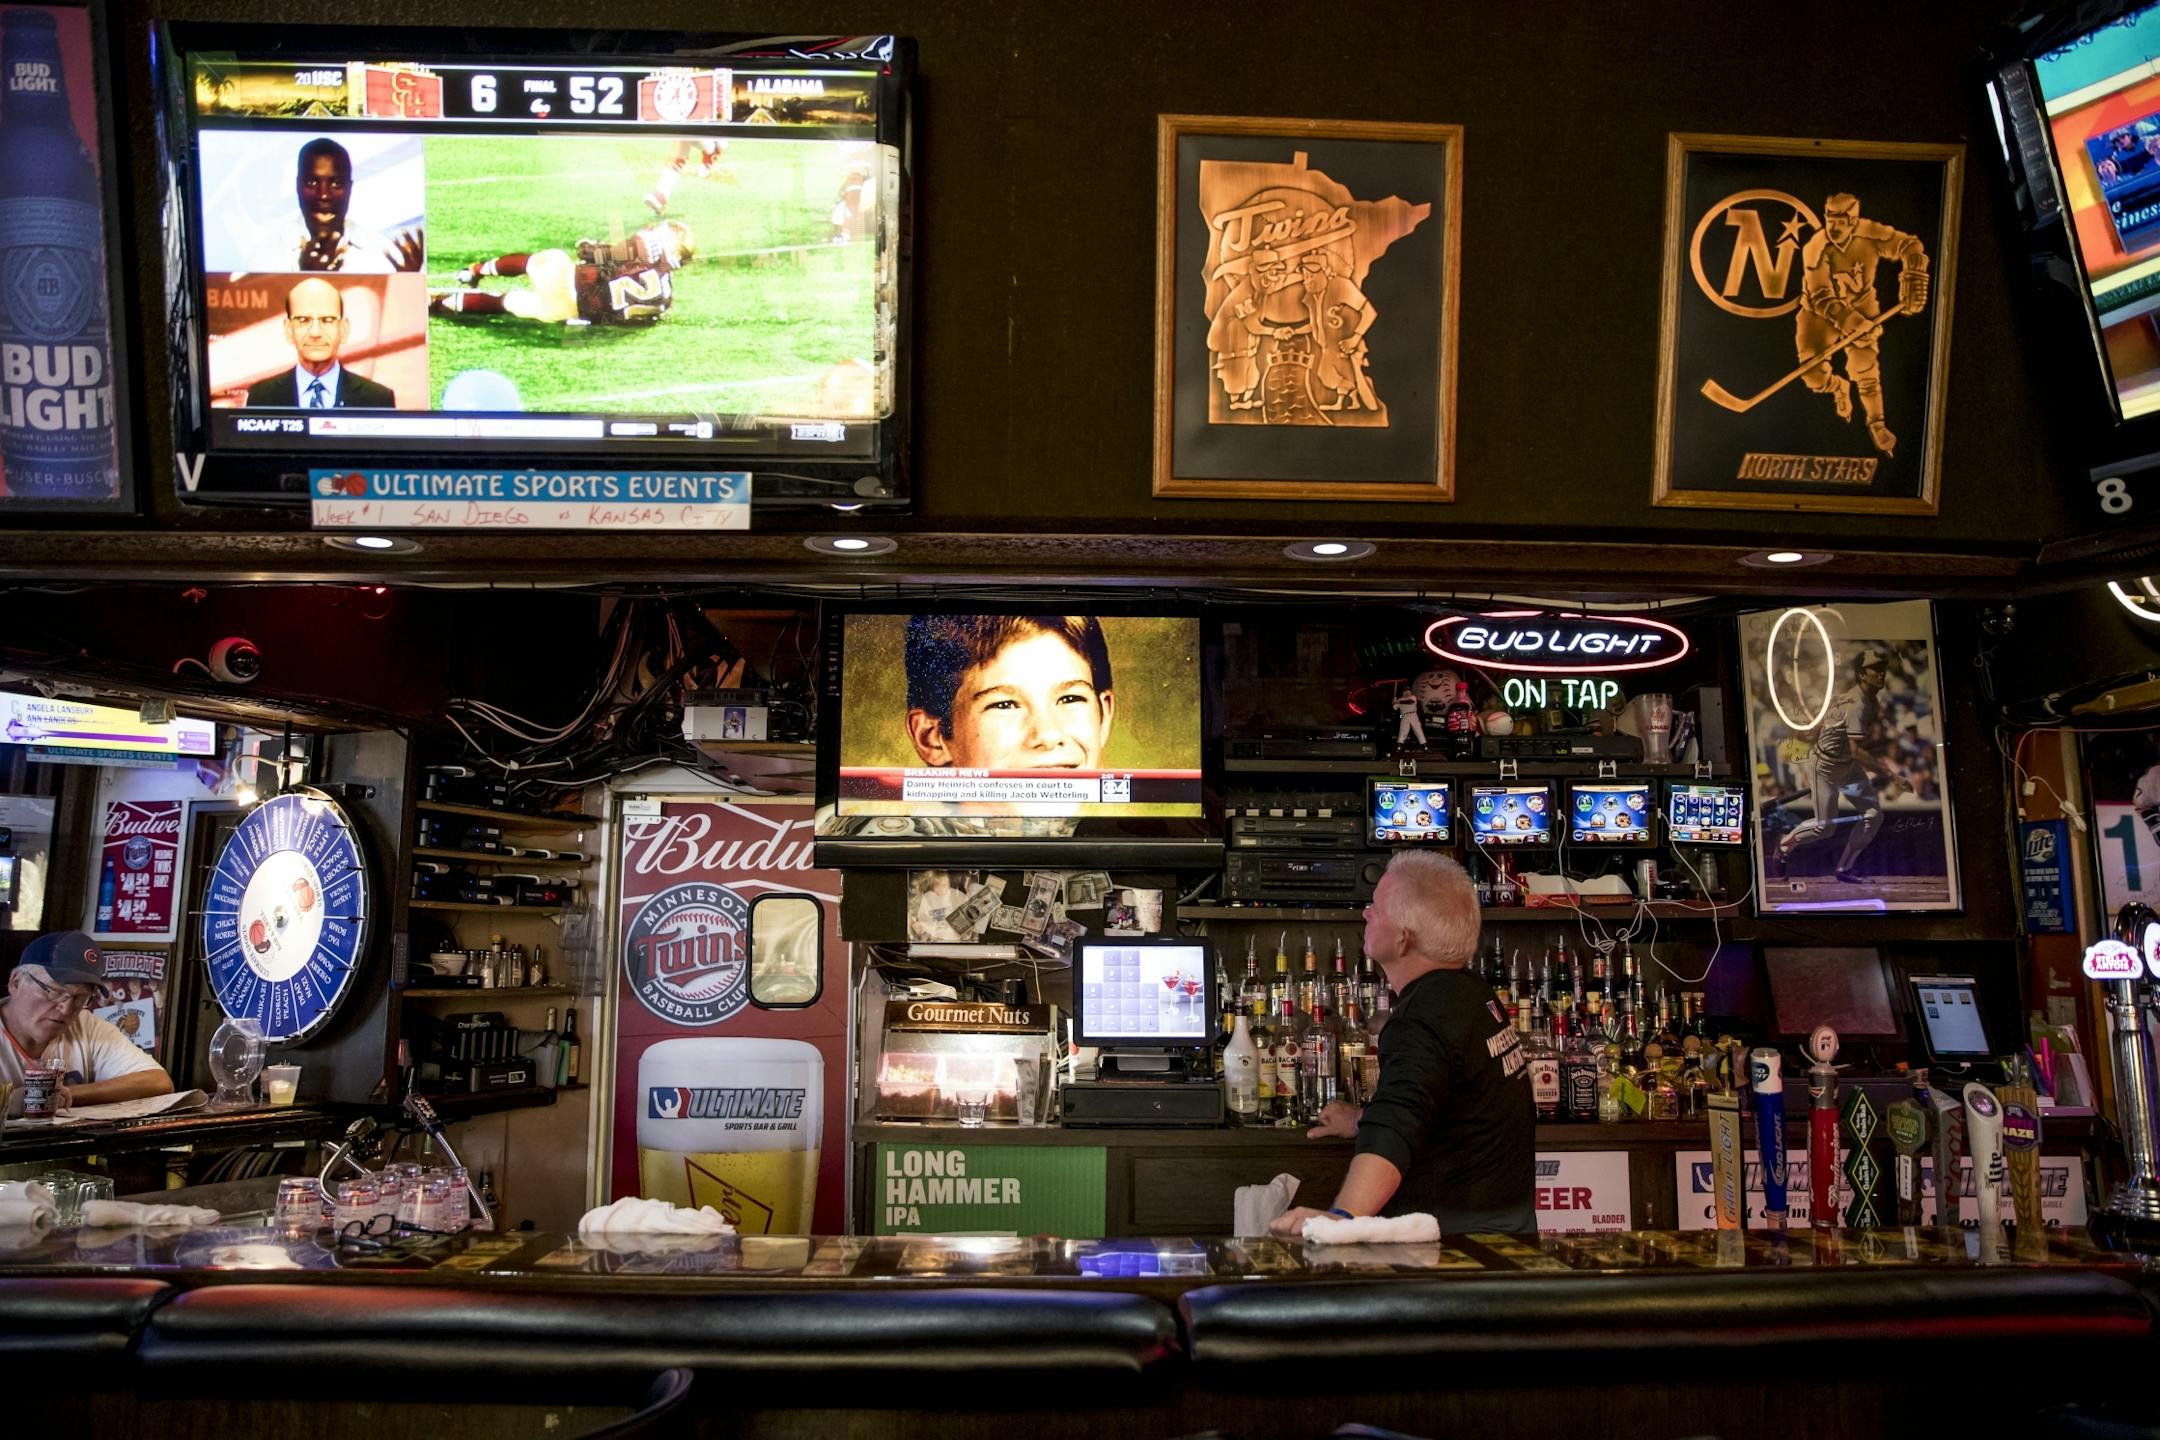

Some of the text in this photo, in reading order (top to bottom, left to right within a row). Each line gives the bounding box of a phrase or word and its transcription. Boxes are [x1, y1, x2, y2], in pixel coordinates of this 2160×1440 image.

[15, 62, 51, 77] BUD
[312, 70, 343, 86] USC
[10, 76, 57, 92] LIGHT
[470, 75, 497, 113] 6
[523, 80, 557, 93] FINAL
[569, 76, 624, 114] 52
[753, 78, 825, 94] ALABAMA
[1213, 201, 1357, 252] Twins
[207, 288, 269, 309] BAUM
[1234, 298, 1256, 320] M
[1327, 305, 1344, 329] S
[2, 343, 102, 387] BUD
[237, 419, 304, 432] NCAAF T25
[177, 453, 206, 492] V
[1740, 455, 1807, 480] NORTH
[373, 474, 735, 498] ULTIMATE SPORTS EVENTS
[2096, 478, 2133, 514] 8
[411, 510, 451, 526] SAN
[588, 504, 666, 525] KANSAS
[1456, 627, 1662, 654] BUD LIGHT
[1503, 678, 1619, 710] ON TAP
[26, 704, 94, 716] ANGELA LANSBURY
[904, 768, 990, 777] BREAKING NEWS
[907, 780, 936, 789] Danny
[938, 780, 976, 789] Heinrich
[978, 780, 1023, 789] confesses
[1025, 781, 1034, 789] in
[907, 790, 958, 799] kidnapping
[980, 790, 1007, 799] killing
[1010, 791, 1037, 799] Jacob
[1040, 791, 1089, 800] Wetterling
[306, 823, 325, 853] SAUCE
[321, 848, 344, 873] SNACK
[2104, 815, 2142, 891] 1
[323, 857, 349, 885] SCOOBY
[214, 931, 237, 941] NORRIS
[215, 920, 236, 929] CHUCK
[329, 922, 348, 936] BOMB
[84, 949, 99, 965] C
[317, 952, 334, 973] BOMB
[309, 960, 332, 984] CHERRY
[228, 968, 249, 1005] OATMEAL
[235, 978, 253, 1009] COOKIE
[294, 982, 306, 1007] DEAD
[301, 976, 313, 999] NAZI
[643, 983, 713, 1018] BASEBALL
[908, 1004, 1030, 1025] Gourmet Nuts
[688, 1088, 806, 1119] ULTIMATE
[724, 1122, 798, 1131] SPORTS BAR & GRILL
[1719, 1112, 1733, 1164] LIGHT
[1774, 1112, 1783, 1152] LIGHT
[886, 1150, 966, 1177] LONG
[886, 1178, 1021, 1204] HAMMER
[886, 1206, 921, 1226] IPA
[1592, 1215, 1626, 1224] BLADDER
